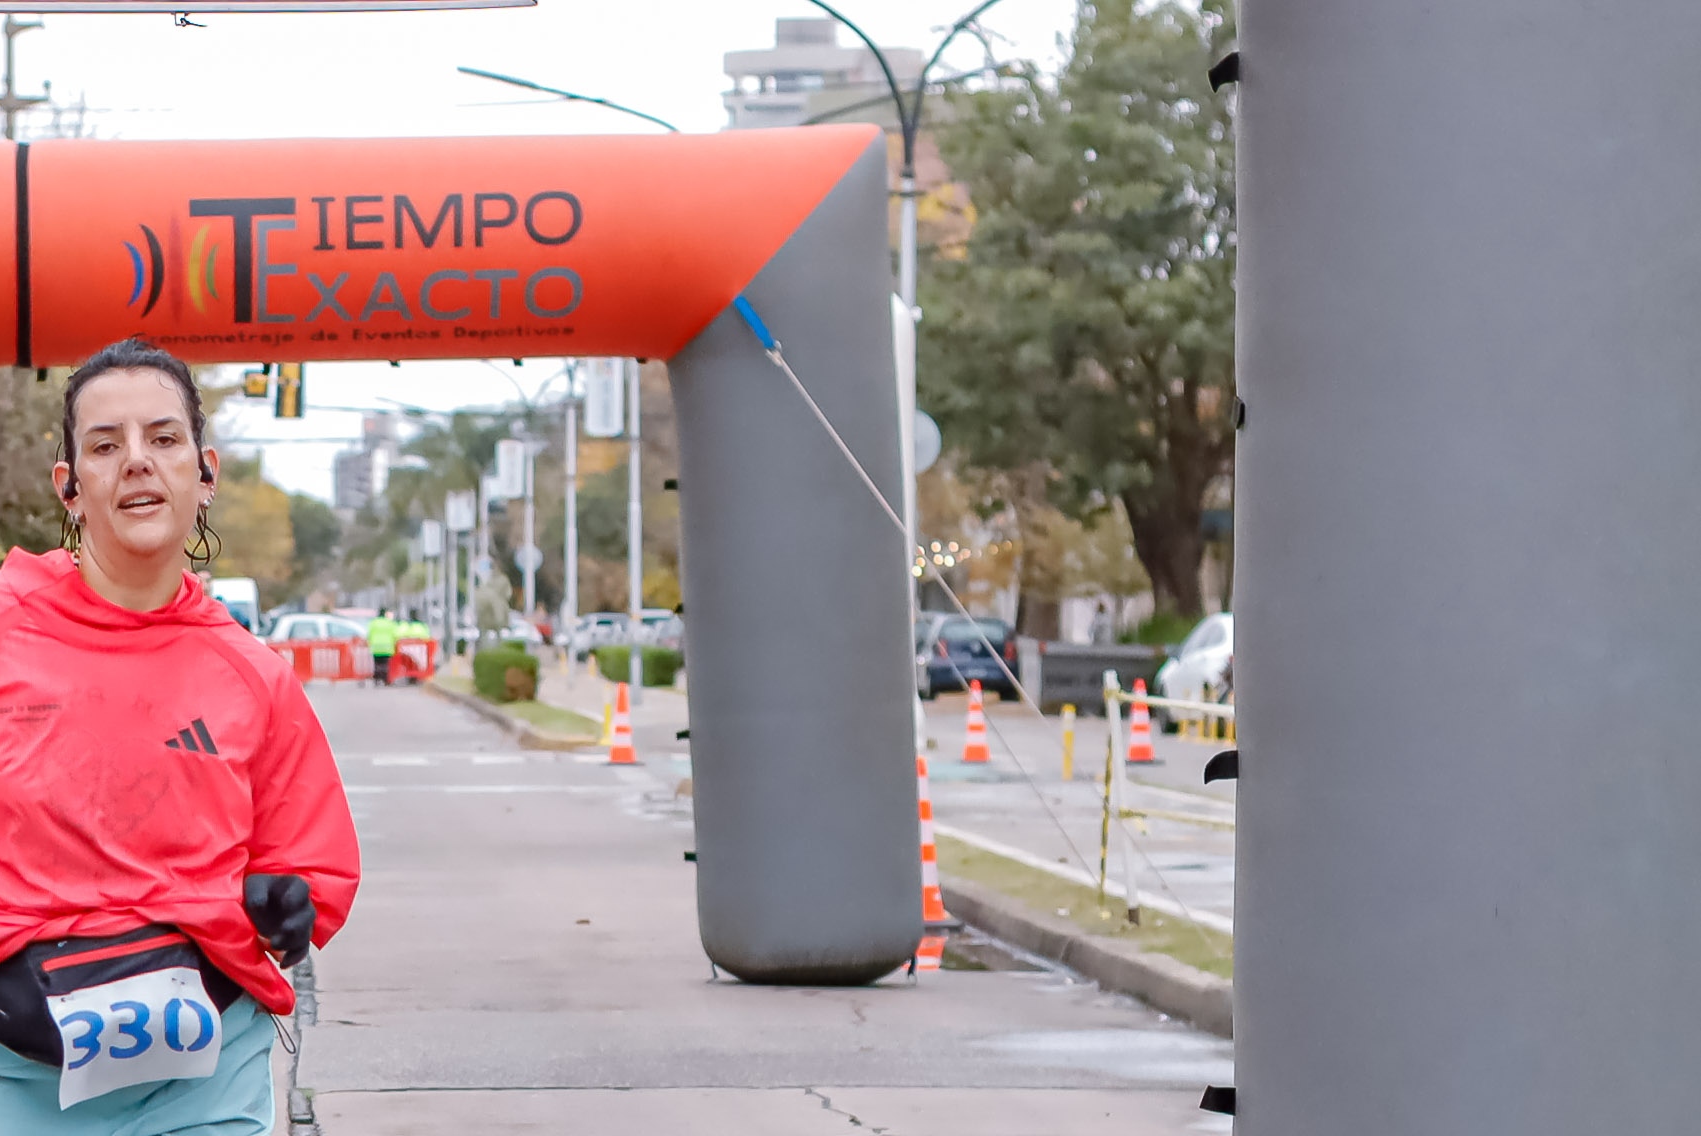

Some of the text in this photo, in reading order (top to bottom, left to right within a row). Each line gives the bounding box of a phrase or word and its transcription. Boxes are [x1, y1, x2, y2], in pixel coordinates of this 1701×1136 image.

[189, 191, 583, 323] TIEMPO
[256, 219, 584, 324] EXACTO
[148, 326, 575, 347] ronometraje de Eventos Deportivos
[59, 997, 214, 1070] 330
